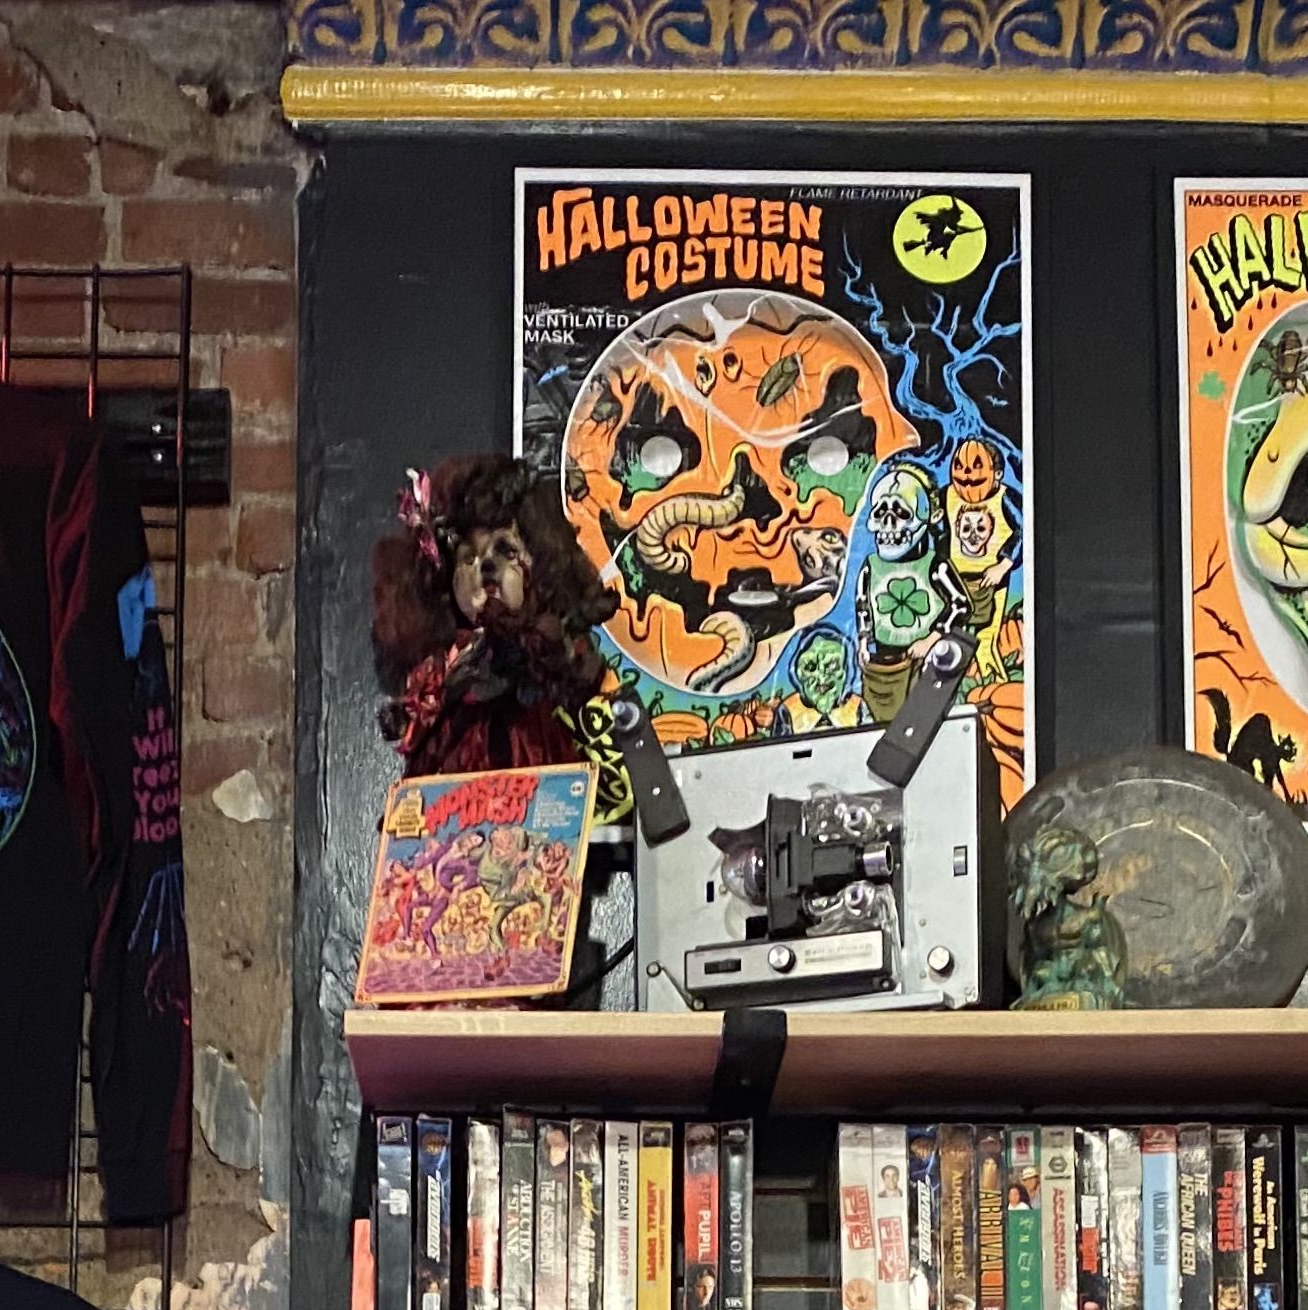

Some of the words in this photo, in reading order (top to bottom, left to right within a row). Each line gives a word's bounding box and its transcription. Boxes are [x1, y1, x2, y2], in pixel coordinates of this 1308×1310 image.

[1188, 195, 1303, 207] MASQUERADE
[537, 189, 821, 271] HALLOWEEN
[626, 237, 825, 300] COSTUME
[524, 313, 629, 329] VENTILATED
[524, 329, 575, 344] MASK
[618, 1135, 628, 1220] ALL-AMERICAN
[952, 1171, 964, 1222] ALMOST
[1182, 1174, 1195, 1228] AFRICAN
[1196, 1173, 1207, 1196] THE
[618, 1226, 628, 1276] MURDER
[953, 1226, 965, 1278] HEROES
[1182, 1232, 1196, 1275] QUEEN
